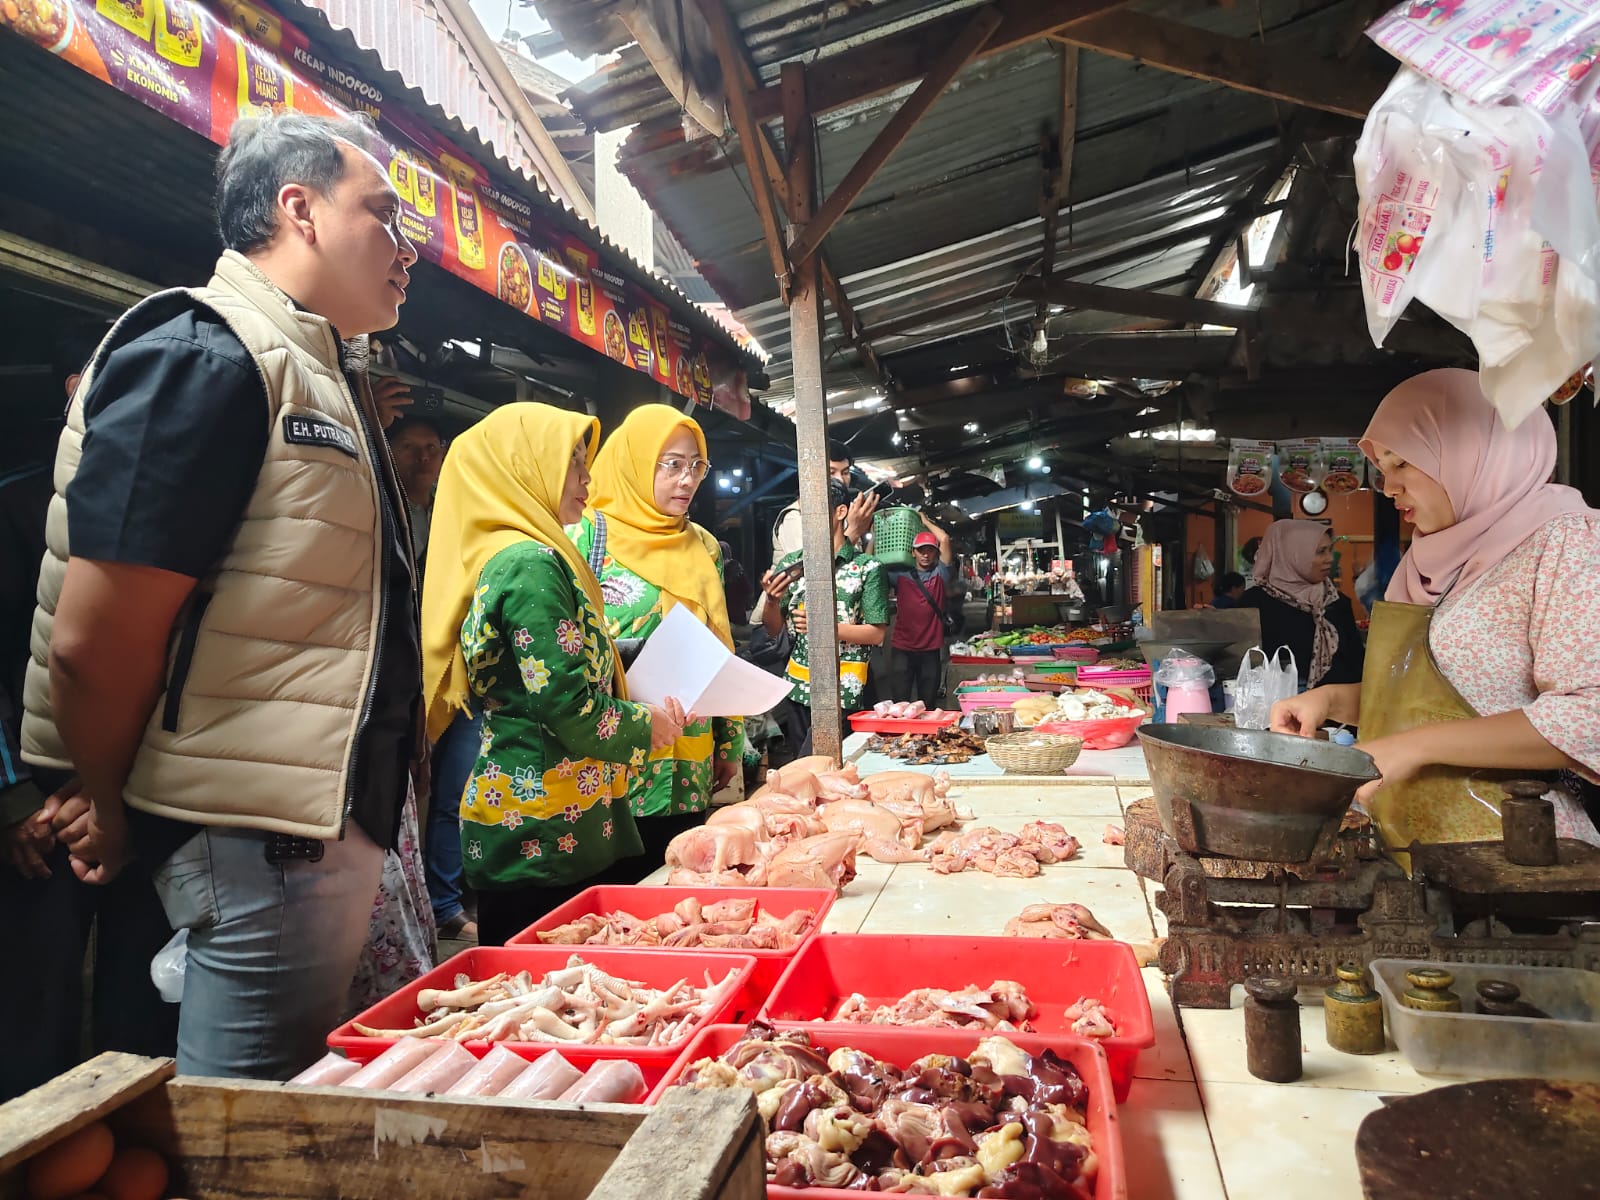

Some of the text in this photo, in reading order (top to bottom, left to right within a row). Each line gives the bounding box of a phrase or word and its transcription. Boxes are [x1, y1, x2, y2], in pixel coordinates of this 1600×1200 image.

[126, 67, 180, 105] EKONOMIS
[254, 63, 277, 84] KECAP
[293, 46, 326, 73] KECAP
[327, 65, 383, 102] INDOFOOD
[255, 80, 278, 101] MANIS
[1371, 228, 1385, 254] TIGA
[1483, 230, 1495, 258] HDPE
[292, 421, 313, 437] E.H.
